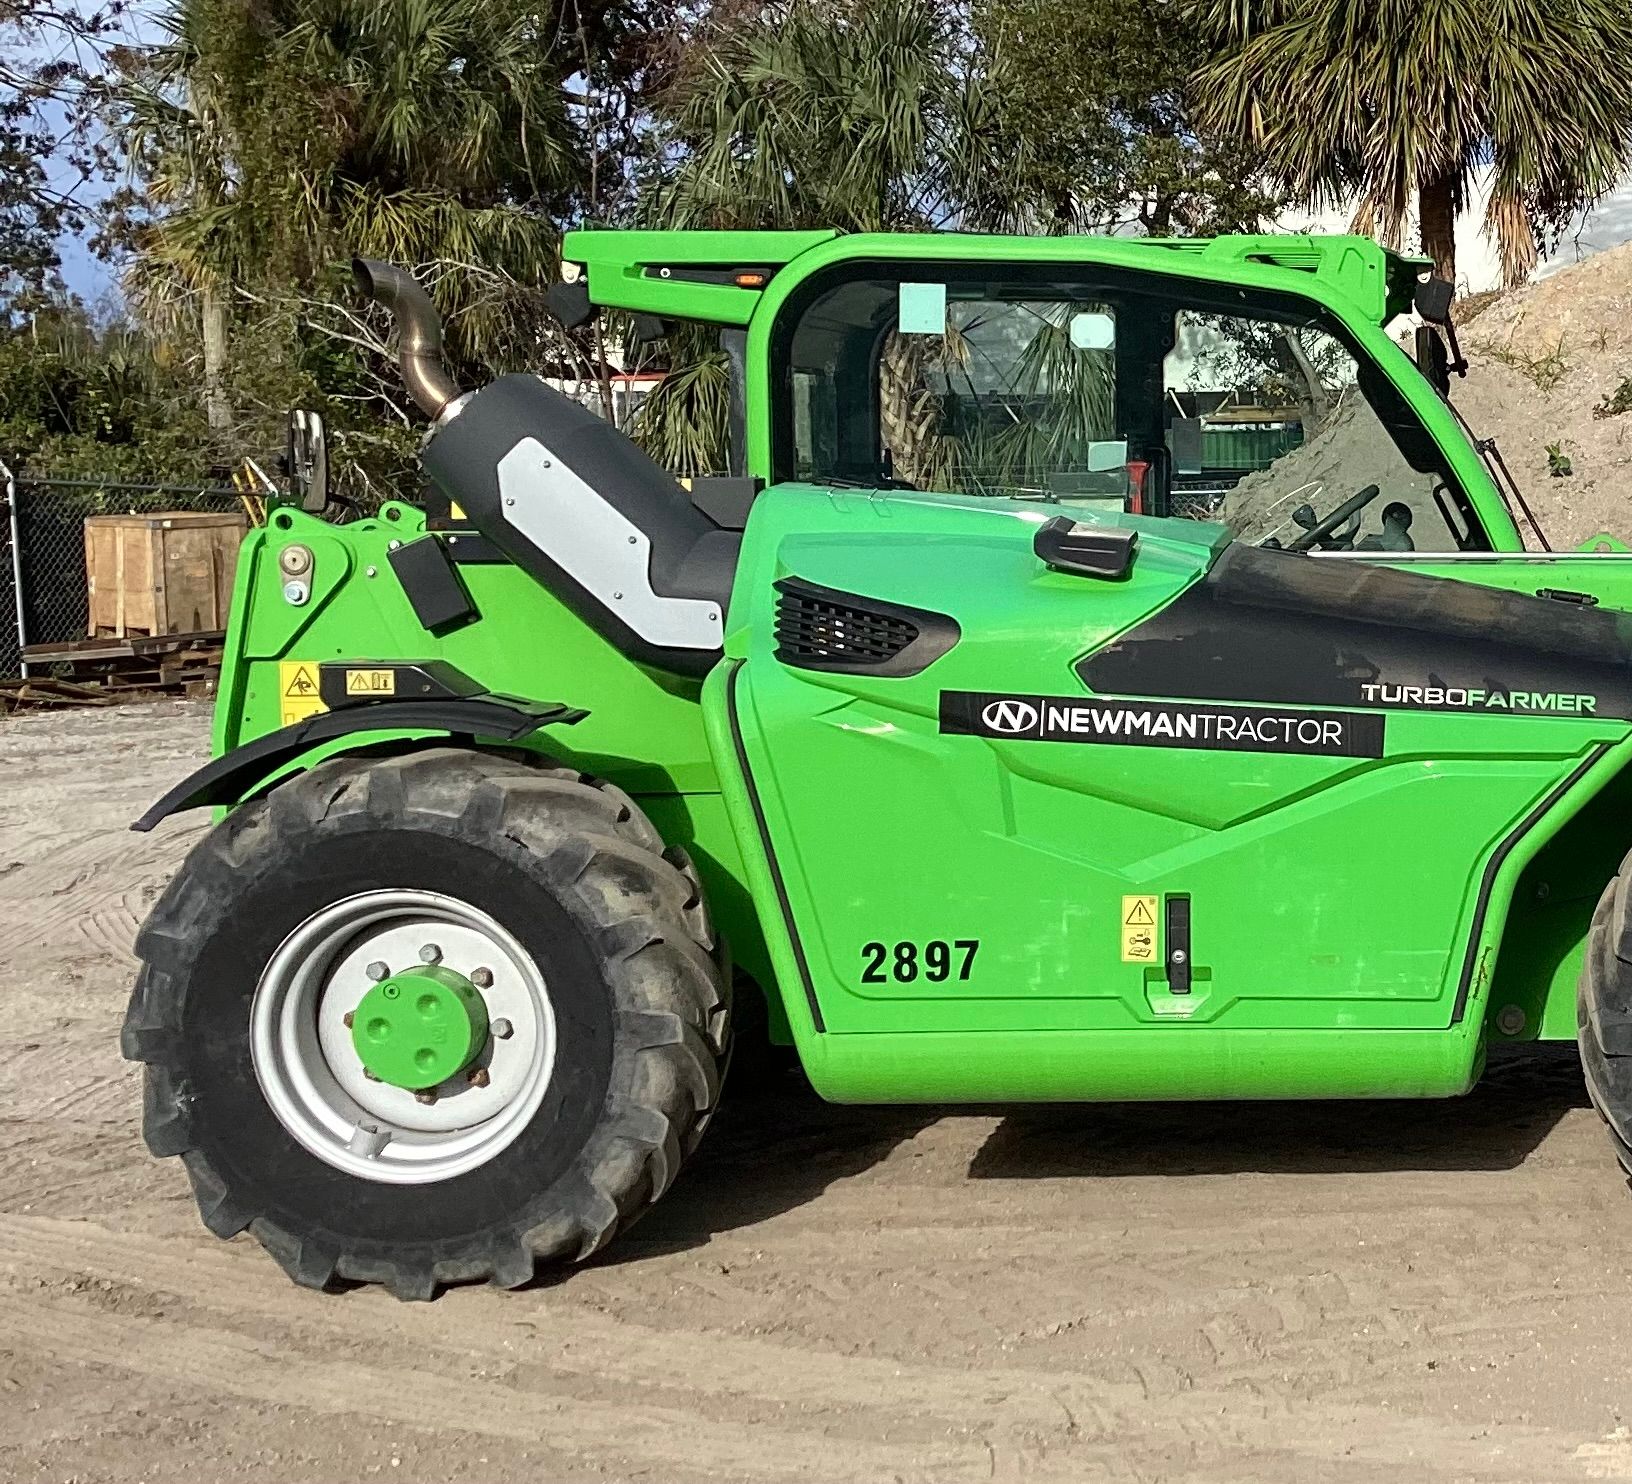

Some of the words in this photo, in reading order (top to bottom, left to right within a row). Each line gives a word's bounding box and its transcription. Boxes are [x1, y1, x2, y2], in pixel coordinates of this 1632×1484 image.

[1361, 684, 1597, 713] TURBOFARMER
[1047, 706, 1342, 746] NEWMANTRACTOR
[861, 940, 980, 983] 2897
